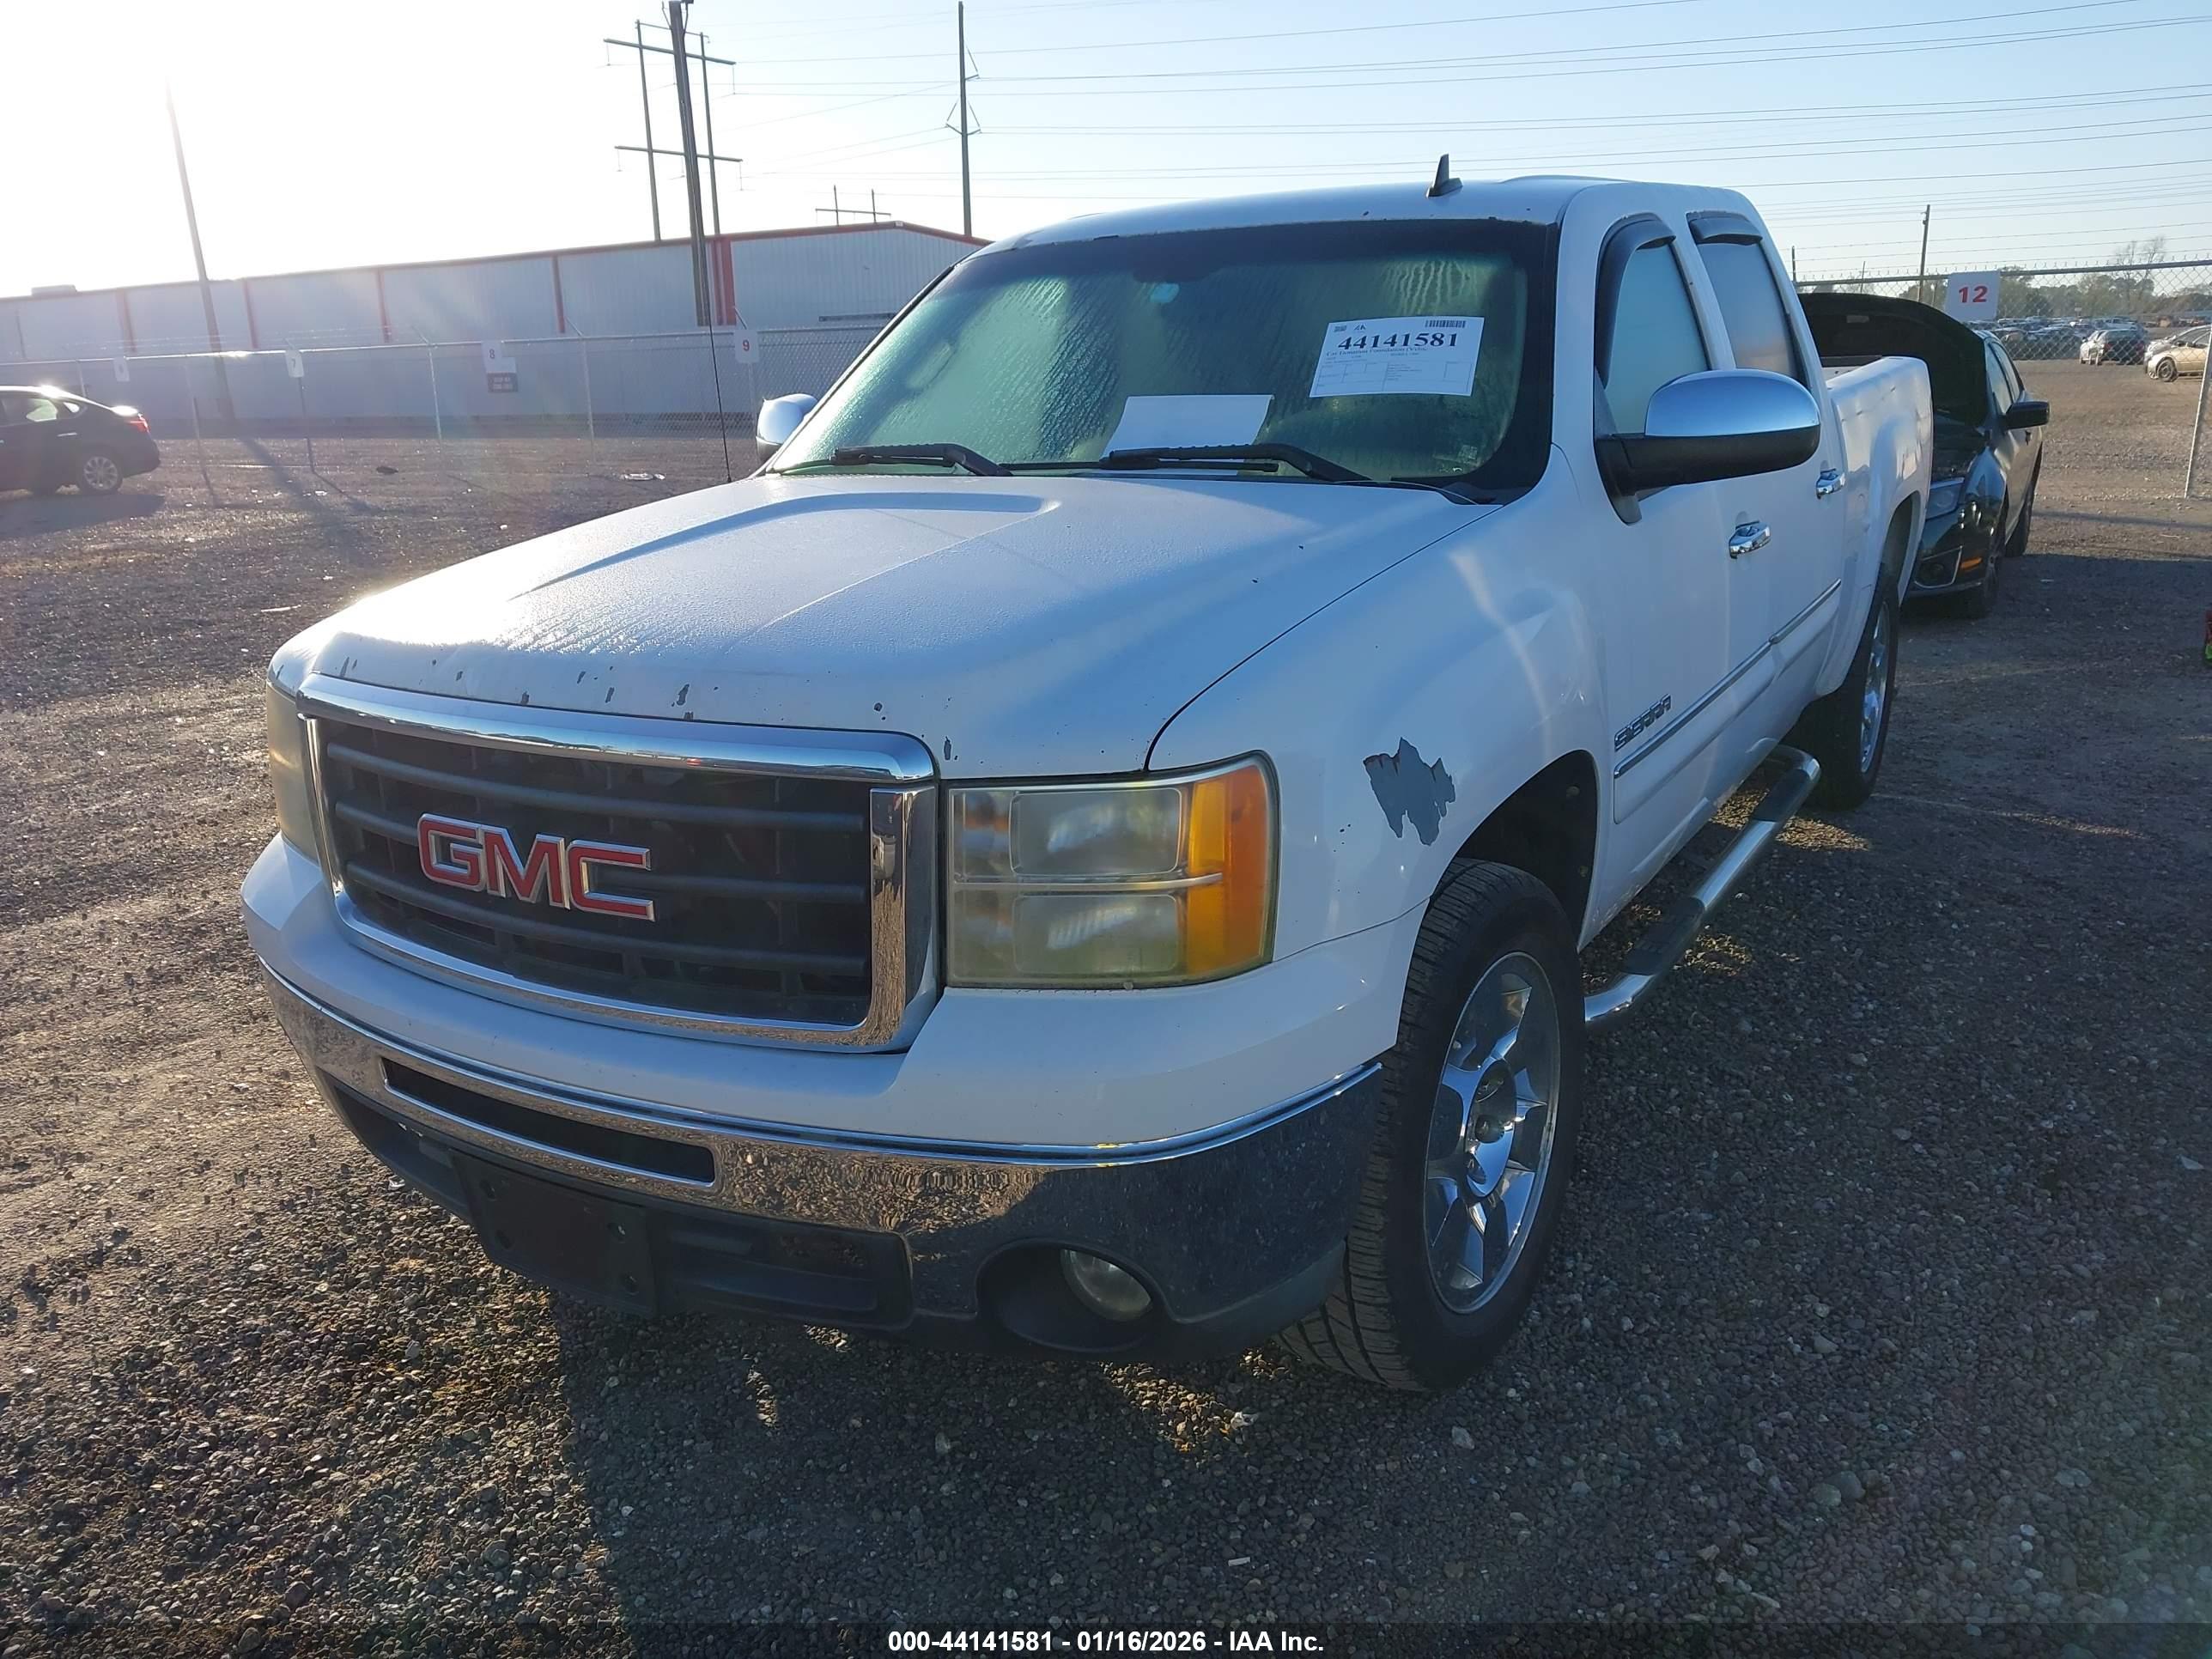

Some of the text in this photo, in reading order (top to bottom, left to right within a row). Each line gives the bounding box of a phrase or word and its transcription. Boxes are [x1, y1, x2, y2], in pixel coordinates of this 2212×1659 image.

[1958, 284, 1988, 303] 12
[742, 338, 750, 352] 9
[1338, 331, 1459, 350] 44141581
[489, 349, 495, 359] 8
[1614, 693, 1672, 752] SIERRA
[417, 812, 656, 922] GMC
